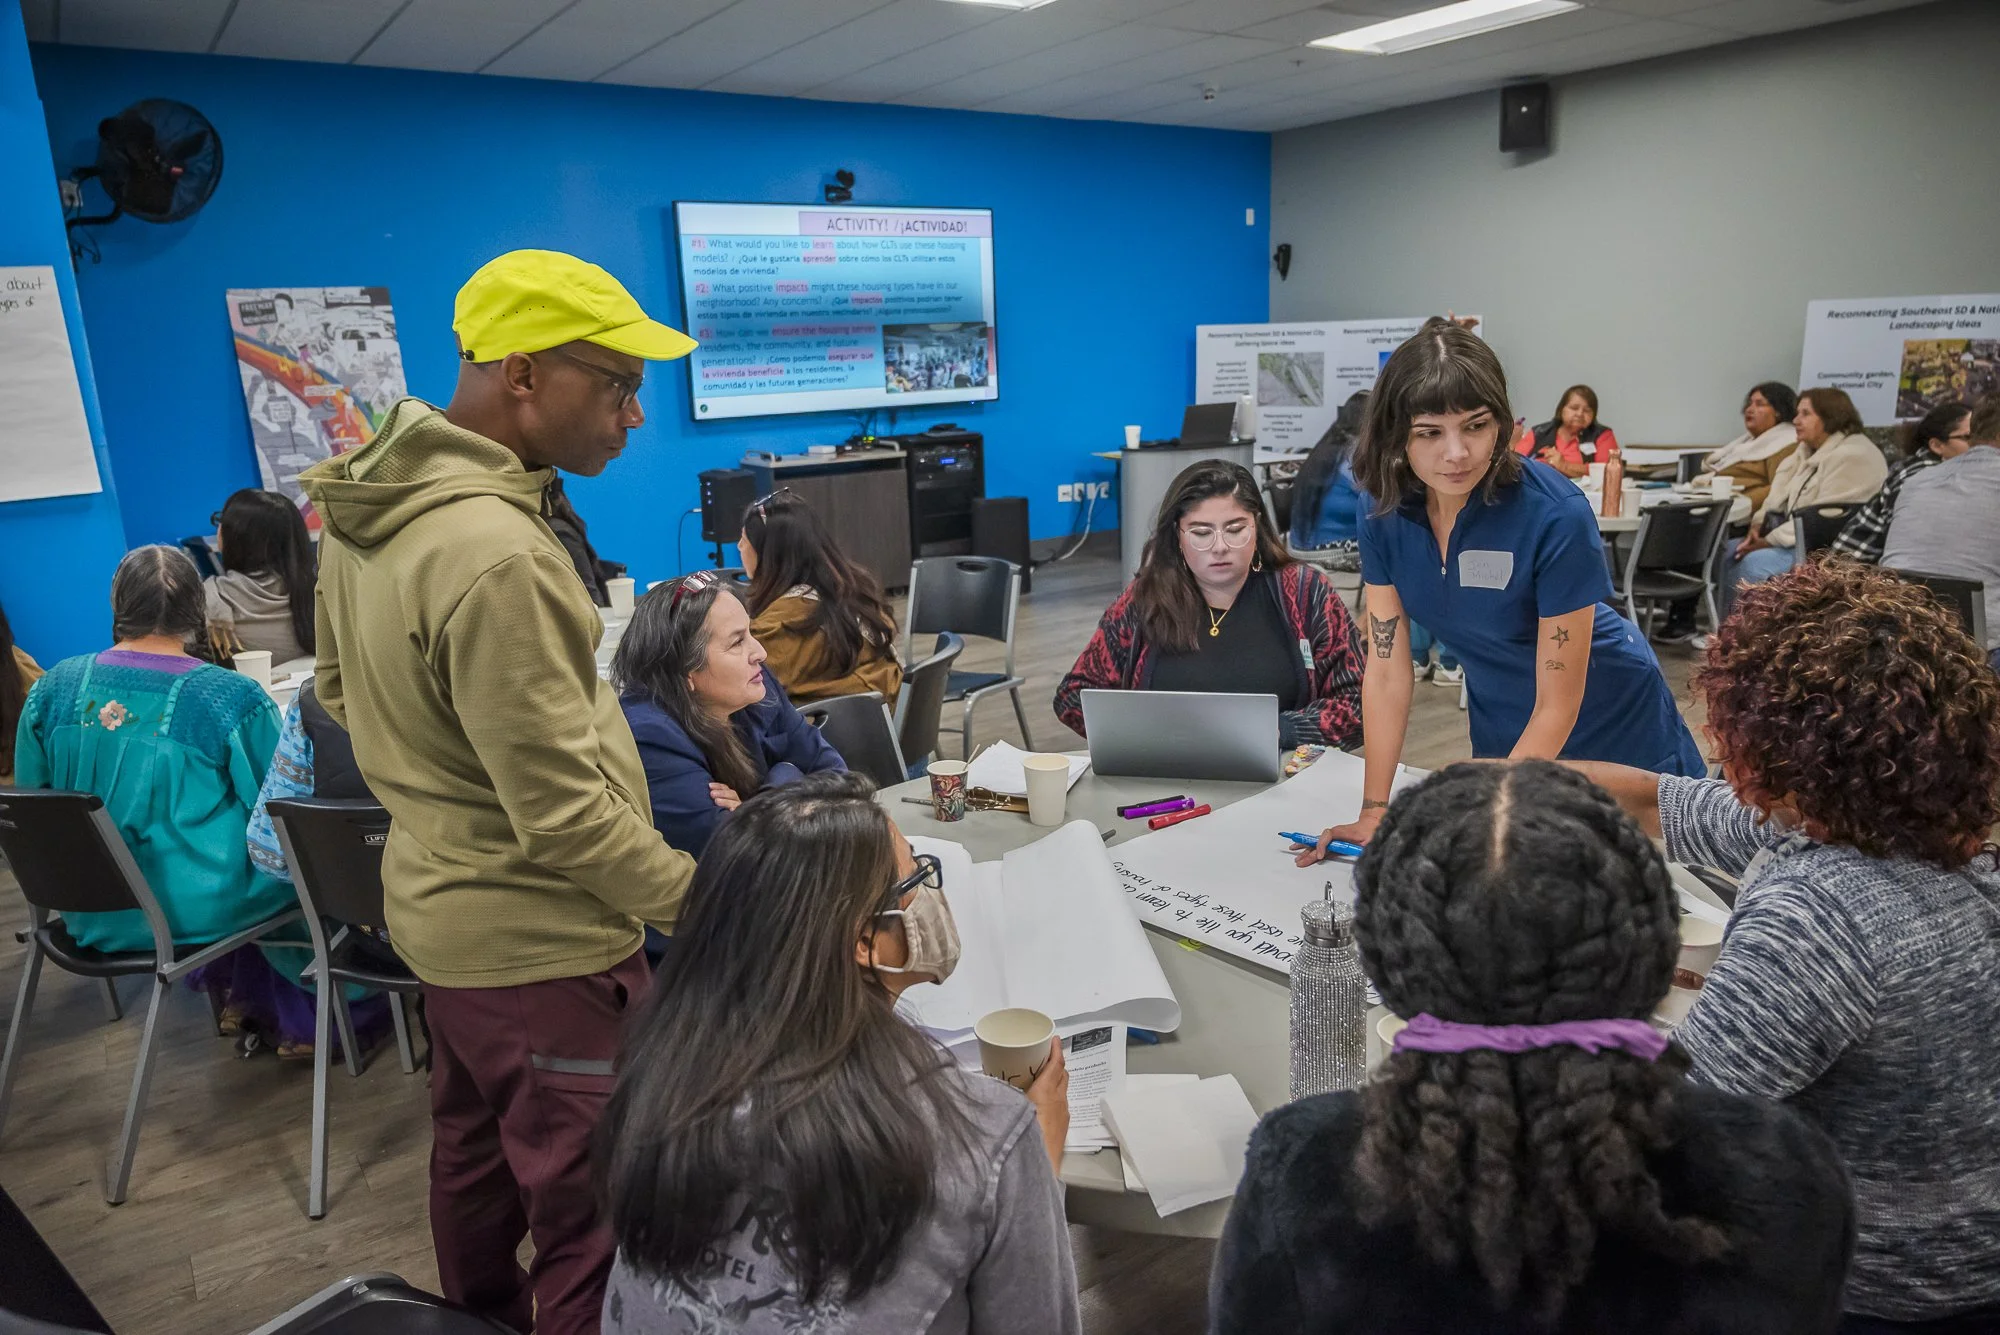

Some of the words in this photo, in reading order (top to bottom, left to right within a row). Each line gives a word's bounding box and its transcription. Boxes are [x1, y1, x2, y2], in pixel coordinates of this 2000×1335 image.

[827, 218, 888, 232] ACTIVITY!
[710, 240, 732, 248] What
[736, 240, 762, 249] would
[765, 242, 780, 250] you
[782, 240, 798, 249] like
[801, 241, 810, 249] to
[812, 240, 834, 249] learn
[836, 241, 860, 249] about
[862, 241, 878, 249] how
[915, 241, 935, 250] these
[938, 241, 966, 251] housing
[693, 254, 728, 262] models?
[6, 276, 46, 290] about
[712, 284, 735, 292] What
[739, 283, 772, 293] positive
[776, 283, 808, 293] impacts
[812, 283, 834, 293] might
[838, 283, 859, 291] these
[862, 282, 891, 292] housing
[894, 283, 914, 291] types
[0, 300, 19, 312] ypes
[25, 296, 35, 307] of
[697, 297, 760, 308] neighborhood?
[763, 298, 778, 307] Any
[782, 296, 822, 305] concerns?
[720, 312, 740, 320] tipos
[1828, 308, 1898, 319] Reconnecting
[1901, 306, 1952, 316] Southeast
[1955, 306, 1968, 315] SD
[1970, 306, 1975, 315] &
[1978, 305, 2000, 315] Nati
[818, 326, 849, 335] housing
[1889, 321, 1953, 330] Landscaping
[1956, 319, 1981, 328] Ideas
[747, 341, 762, 350] the
[702, 356, 756, 368] generations?
[793, 354, 825, 363] podemos
[828, 352, 858, 361] asegurar
[861, 352, 873, 360] que
[712, 370, 745, 378] vivienda
[748, 368, 784, 376] beneficie
[1818, 371, 1863, 380] Community
[704, 381, 746, 391] comunidad
[769, 379, 795, 387] futuras
[798, 376, 849, 387] generaciones?
[1136, 893, 1171, 912] learn
[1173, 890, 1209, 908] types
[1177, 909, 1193, 921] to
[1196, 917, 1220, 934] like
[1248, 919, 1283, 938] used
[1225, 929, 1252, 944] you
[702, 1247, 756, 1284] OTEL
